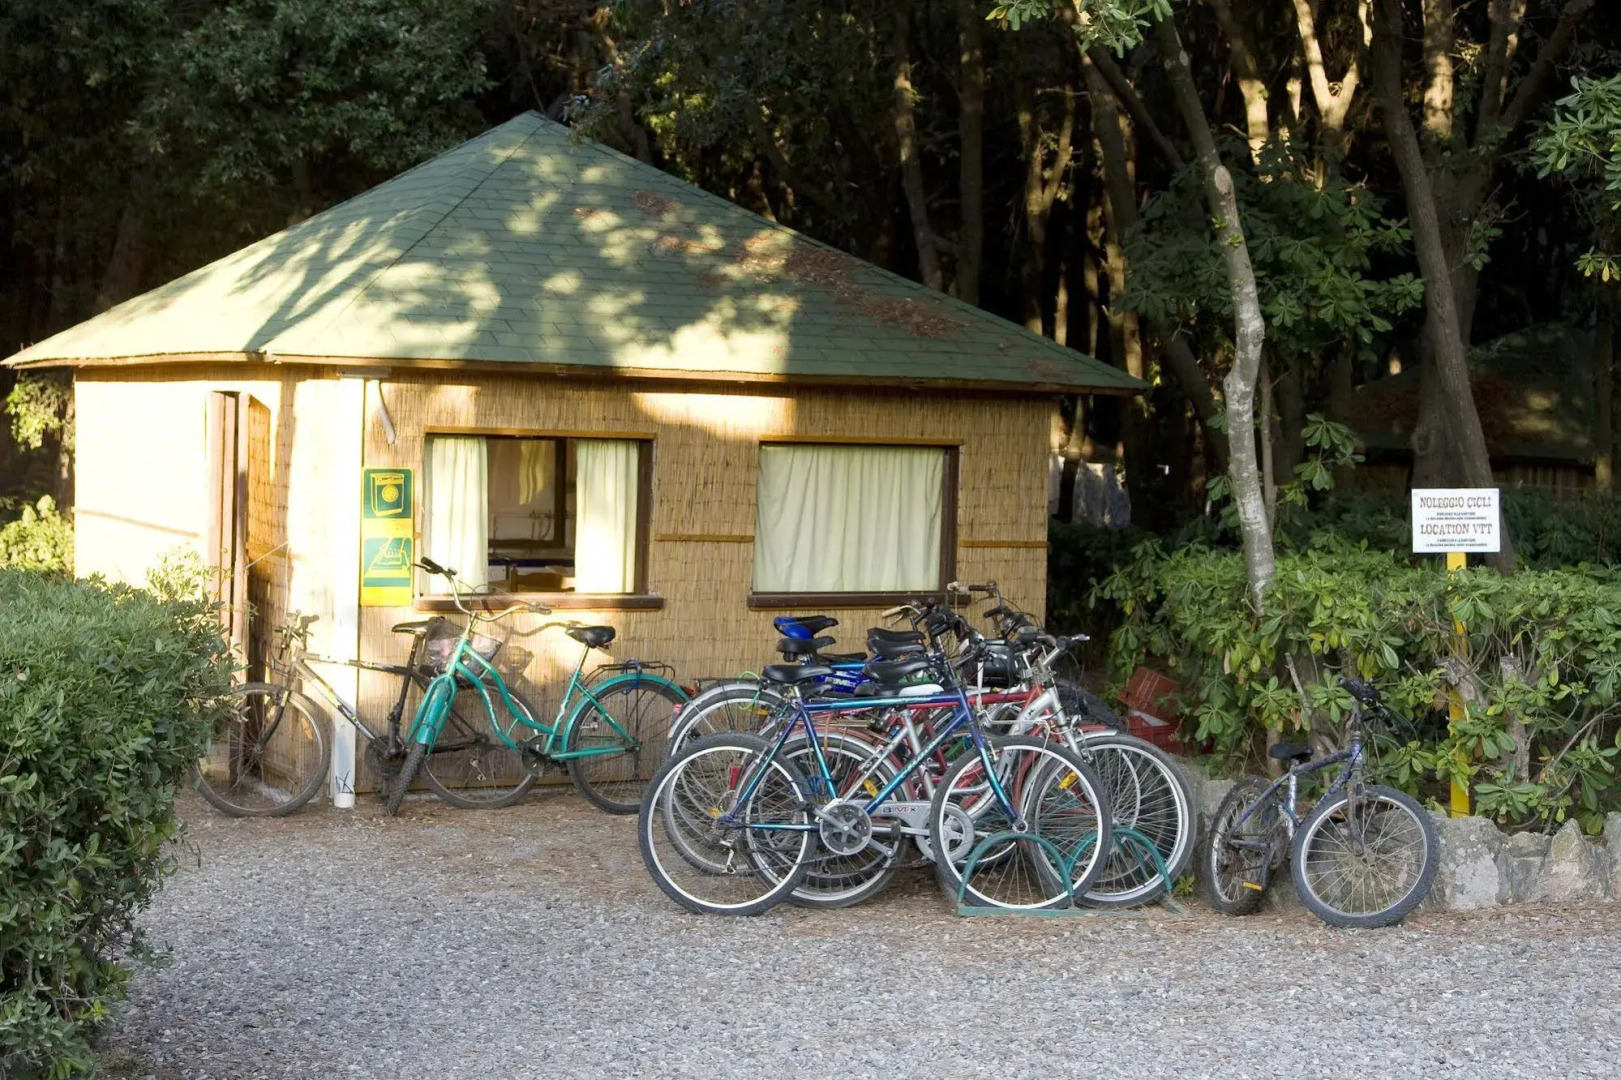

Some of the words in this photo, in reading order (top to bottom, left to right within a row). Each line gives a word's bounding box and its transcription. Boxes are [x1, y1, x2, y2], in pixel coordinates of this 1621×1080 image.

[1420, 496, 1464, 509] NOLEGGIO
[1467, 496, 1491, 508] CICLI
[1420, 523, 1470, 535] LOCATION
[1472, 523, 1493, 534] VTT
